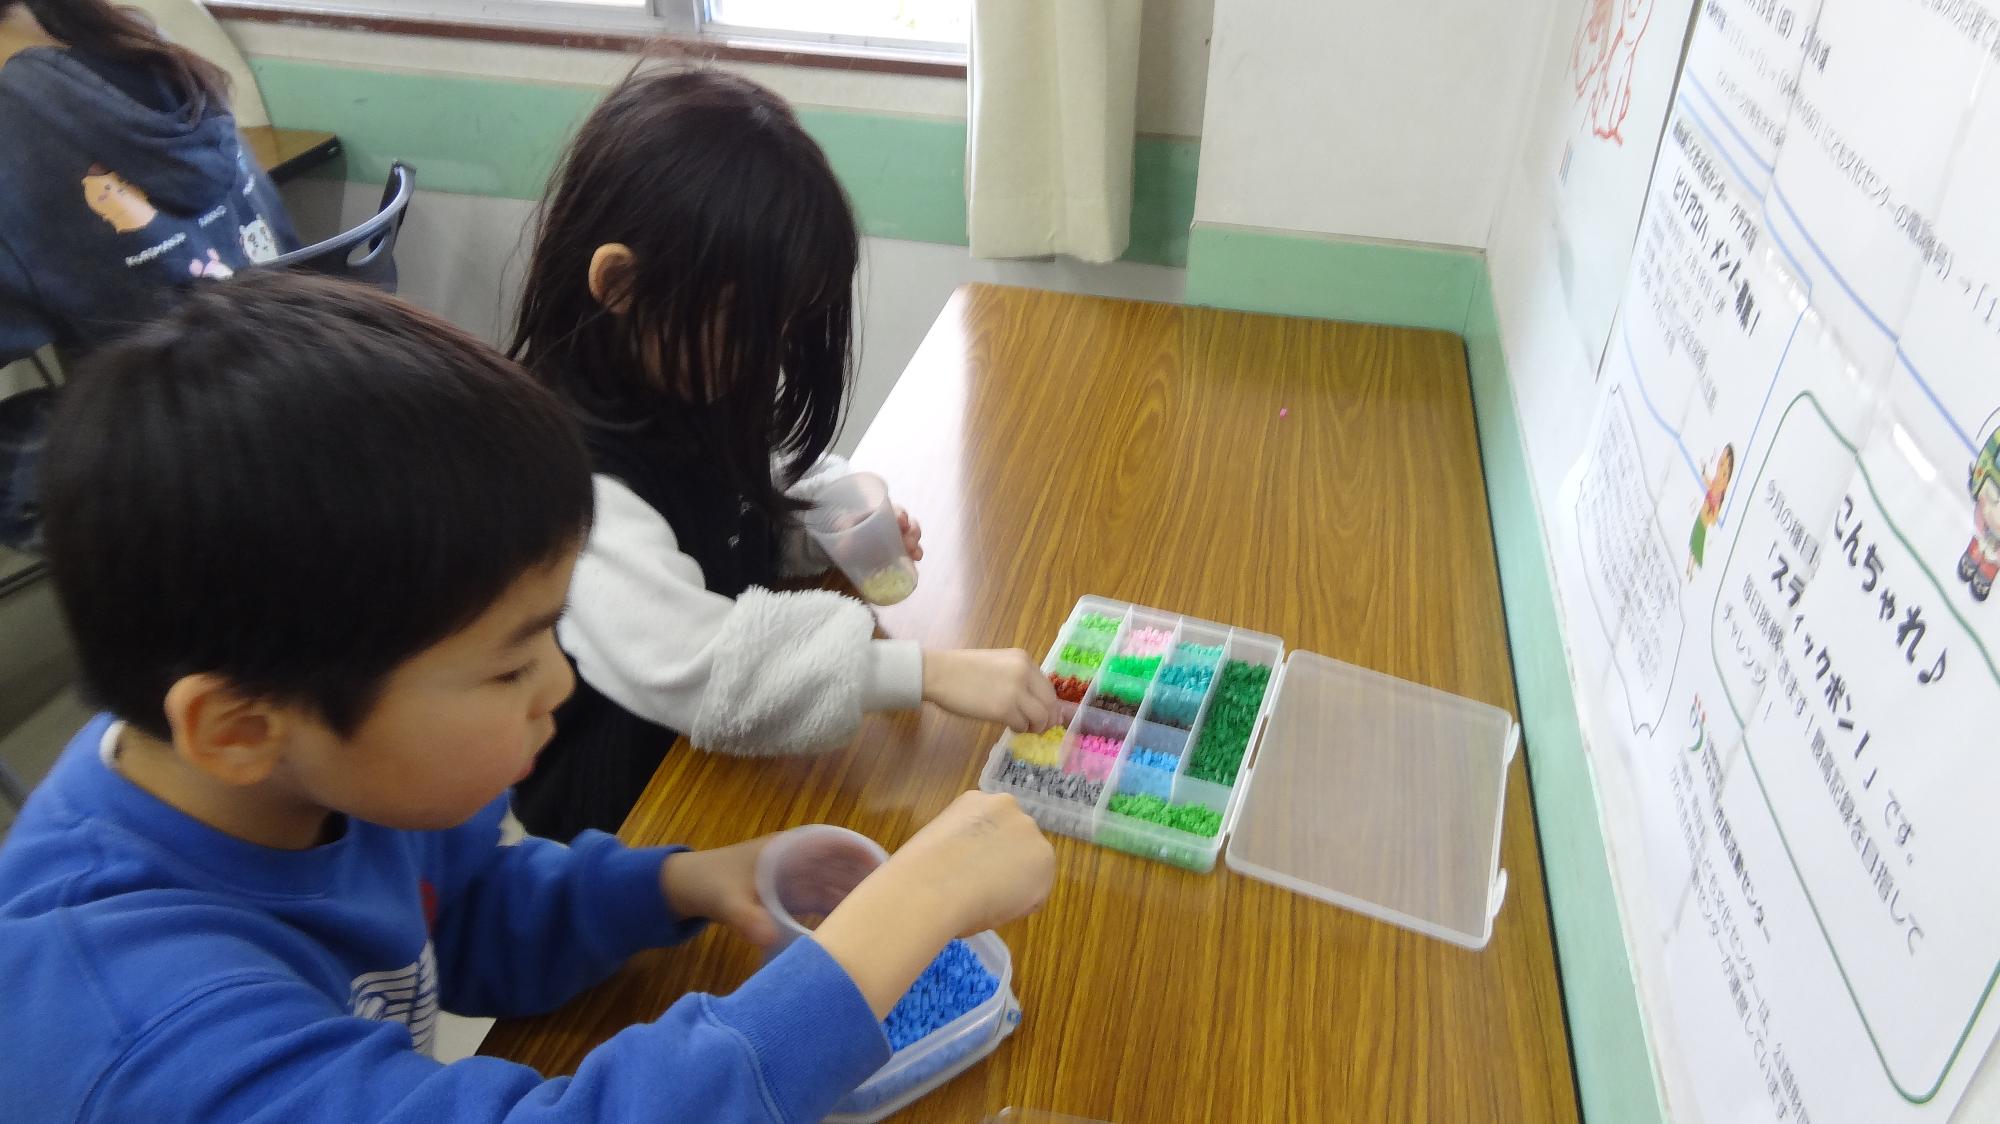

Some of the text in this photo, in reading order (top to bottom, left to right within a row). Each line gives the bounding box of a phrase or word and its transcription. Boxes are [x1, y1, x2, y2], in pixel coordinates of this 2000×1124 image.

[1743, 574, 1924, 955] 毎日挑戦きます！最高記録を目指して
